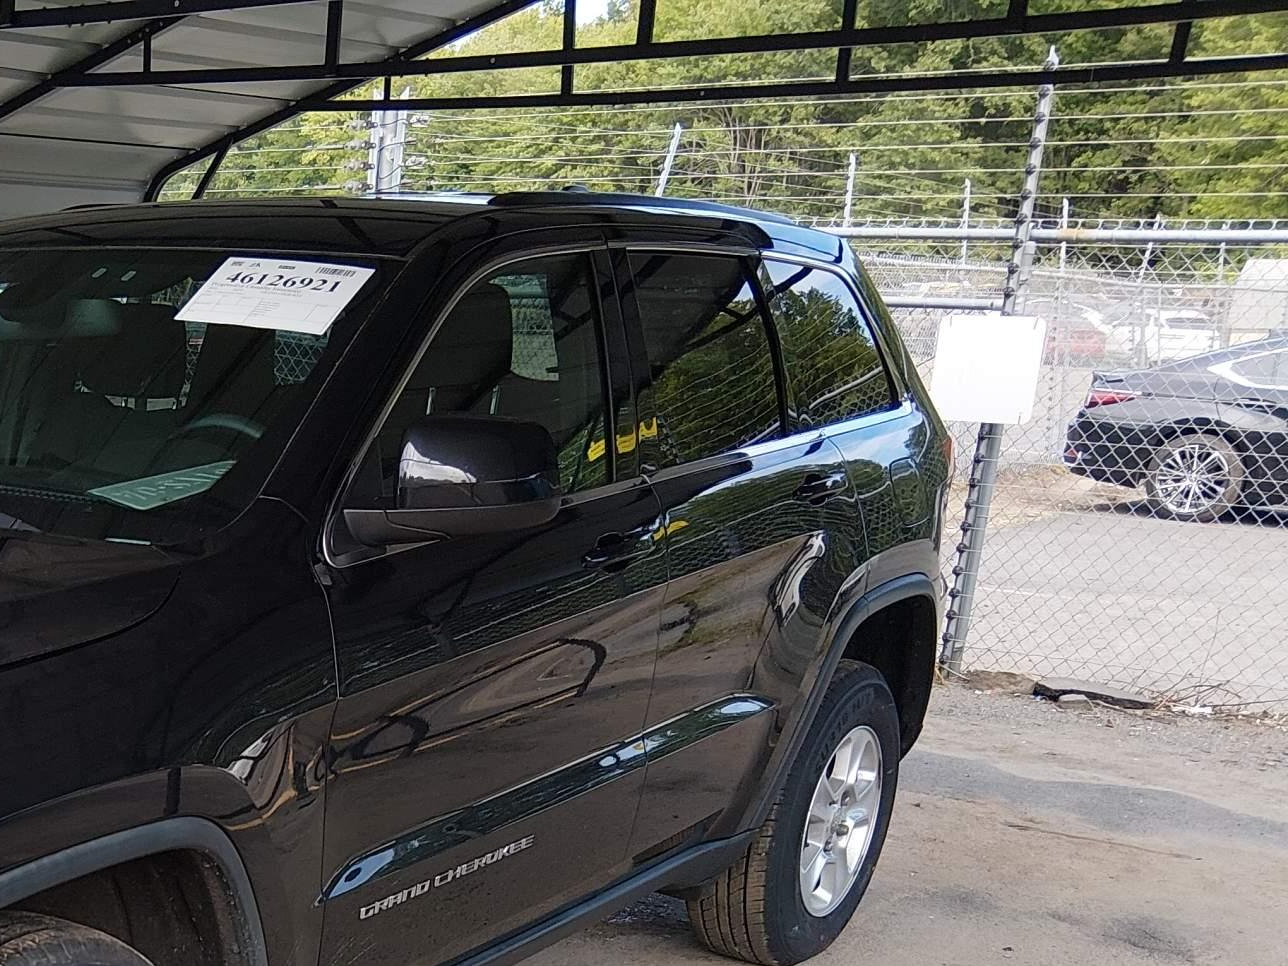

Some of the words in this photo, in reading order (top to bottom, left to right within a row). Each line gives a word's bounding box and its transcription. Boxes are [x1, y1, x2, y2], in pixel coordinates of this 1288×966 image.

[226, 271, 343, 293] 46126921
[358, 879, 431, 919] GRAND
[433, 834, 535, 888] CHEROKEE
